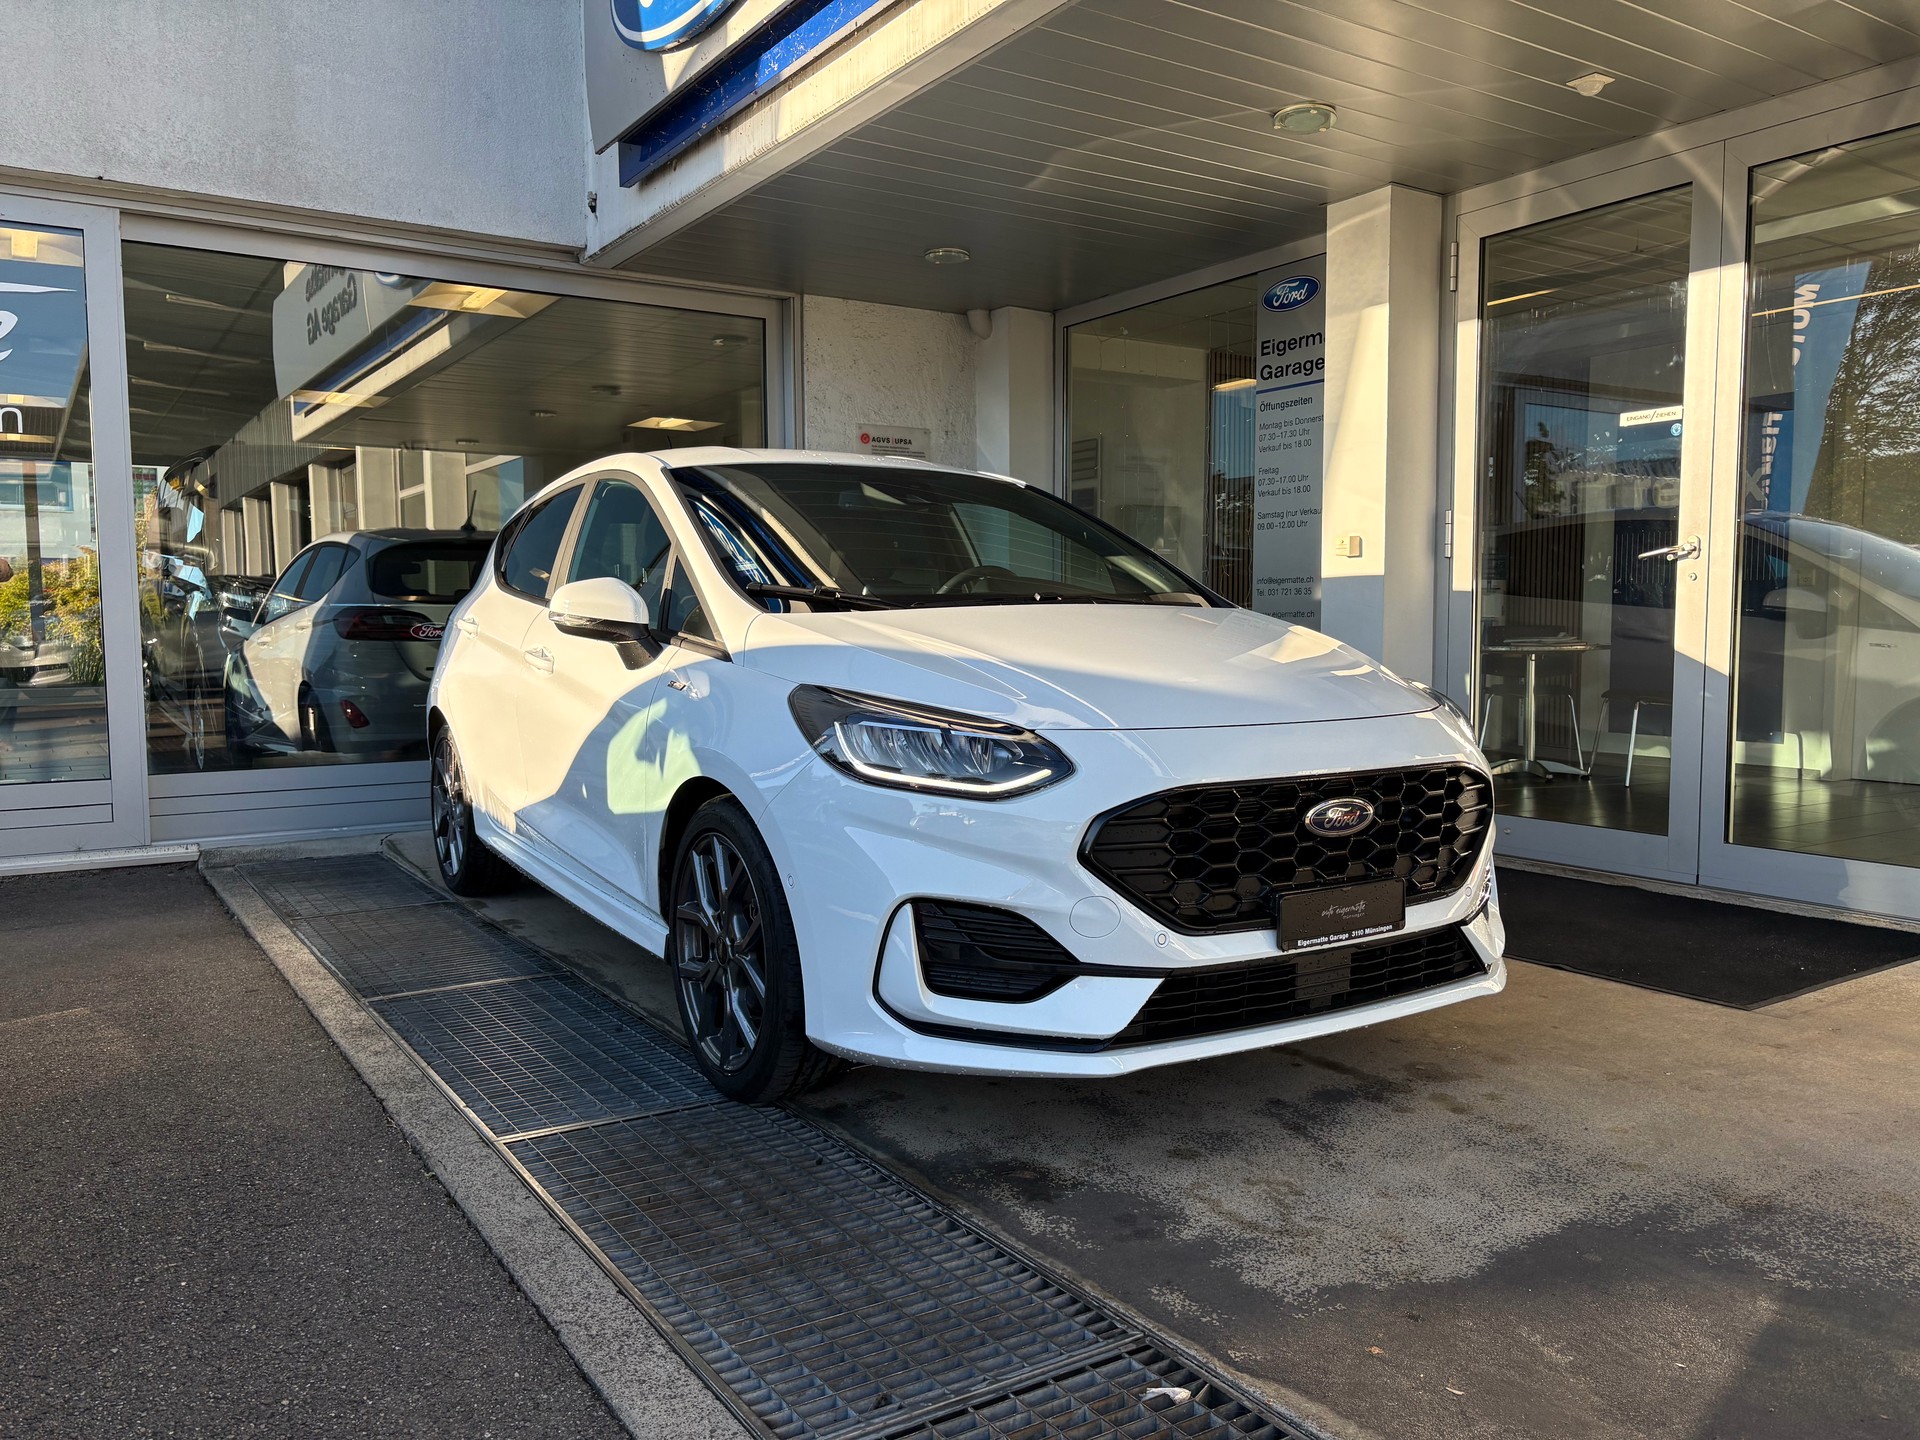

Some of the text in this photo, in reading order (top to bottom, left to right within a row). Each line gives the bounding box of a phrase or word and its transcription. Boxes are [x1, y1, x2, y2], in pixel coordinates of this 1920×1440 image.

[1260, 331, 1325, 357] Eigerm
[1260, 357, 1325, 381] Garage
[1259, 421, 1282, 431] Montag
[1283, 419, 1294, 428] bis
[1298, 427, 1310, 437] Uhr
[871, 436, 891, 444] AGVS
[1258, 438, 1312, 453] Verkauf bis 18.00
[1258, 467, 1279, 476] Freitag
[1297, 474, 1309, 483] Uhr
[1257, 484, 1311, 497] Verkauf bis 18.00
[1257, 510, 1284, 520] Samstag
[1285, 509, 1298, 518] (nur
[1296, 519, 1308, 528] Uhr
[1267, 588, 1279, 597] 031
[1281, 587, 1292, 596] 721
[1303, 586, 1312, 595] 35
[1297, 935, 1329, 947] Eigermatte
[1329, 931, 1349, 942] Garage
[1364, 924, 1393, 936] Münsingen
